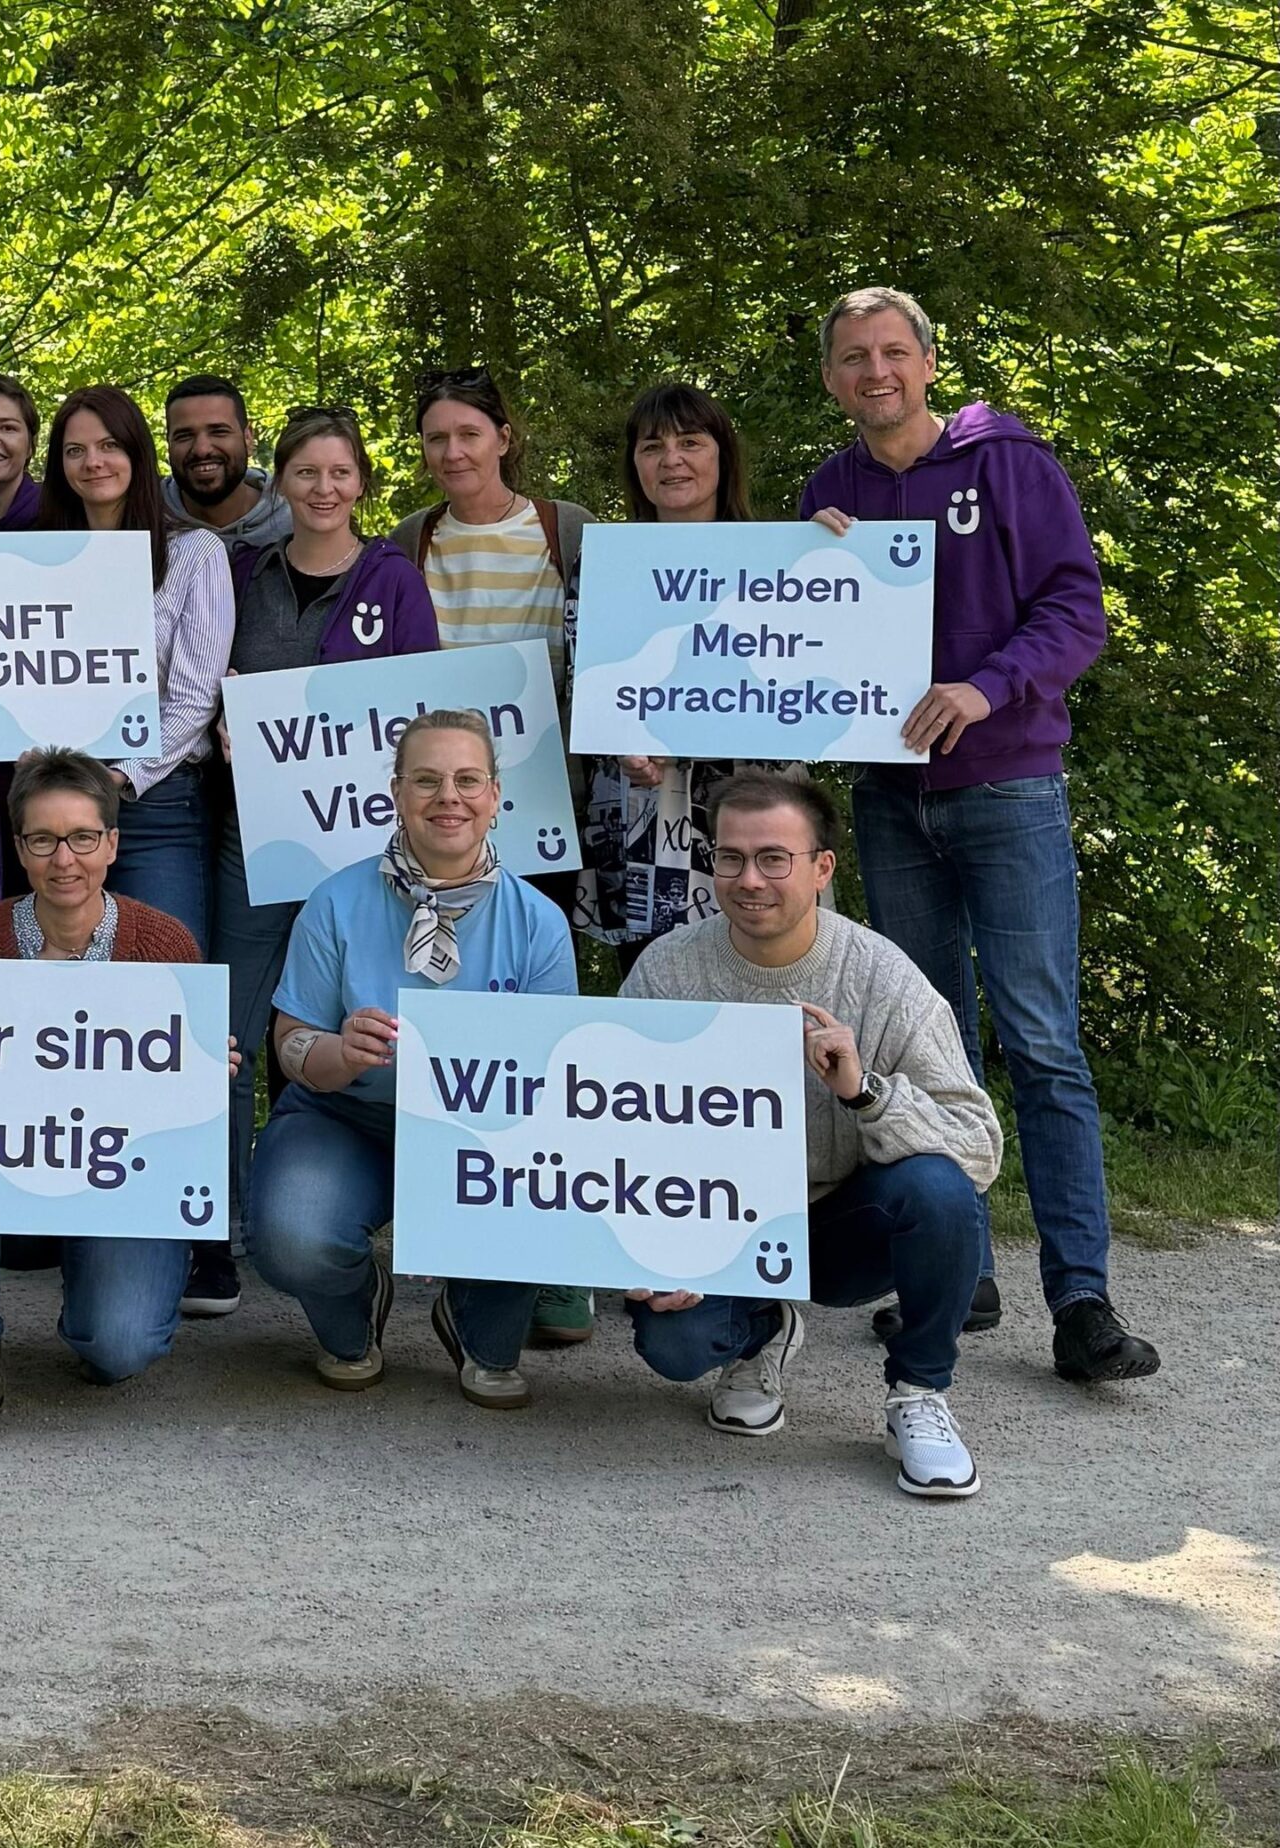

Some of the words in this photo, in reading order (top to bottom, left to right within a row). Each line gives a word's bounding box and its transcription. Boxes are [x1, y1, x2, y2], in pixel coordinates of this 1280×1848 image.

[652, 568, 725, 601] Wir
[739, 569, 859, 602] leben
[693, 624, 823, 657] Mehr-
[616, 679, 900, 725] sprachigkeit.
[257, 713, 353, 763] Wir
[35, 1010, 181, 1072] sind
[429, 1057, 545, 1115] Wir
[567, 1064, 782, 1129] bauen
[457, 1149, 757, 1222] Brücken.
